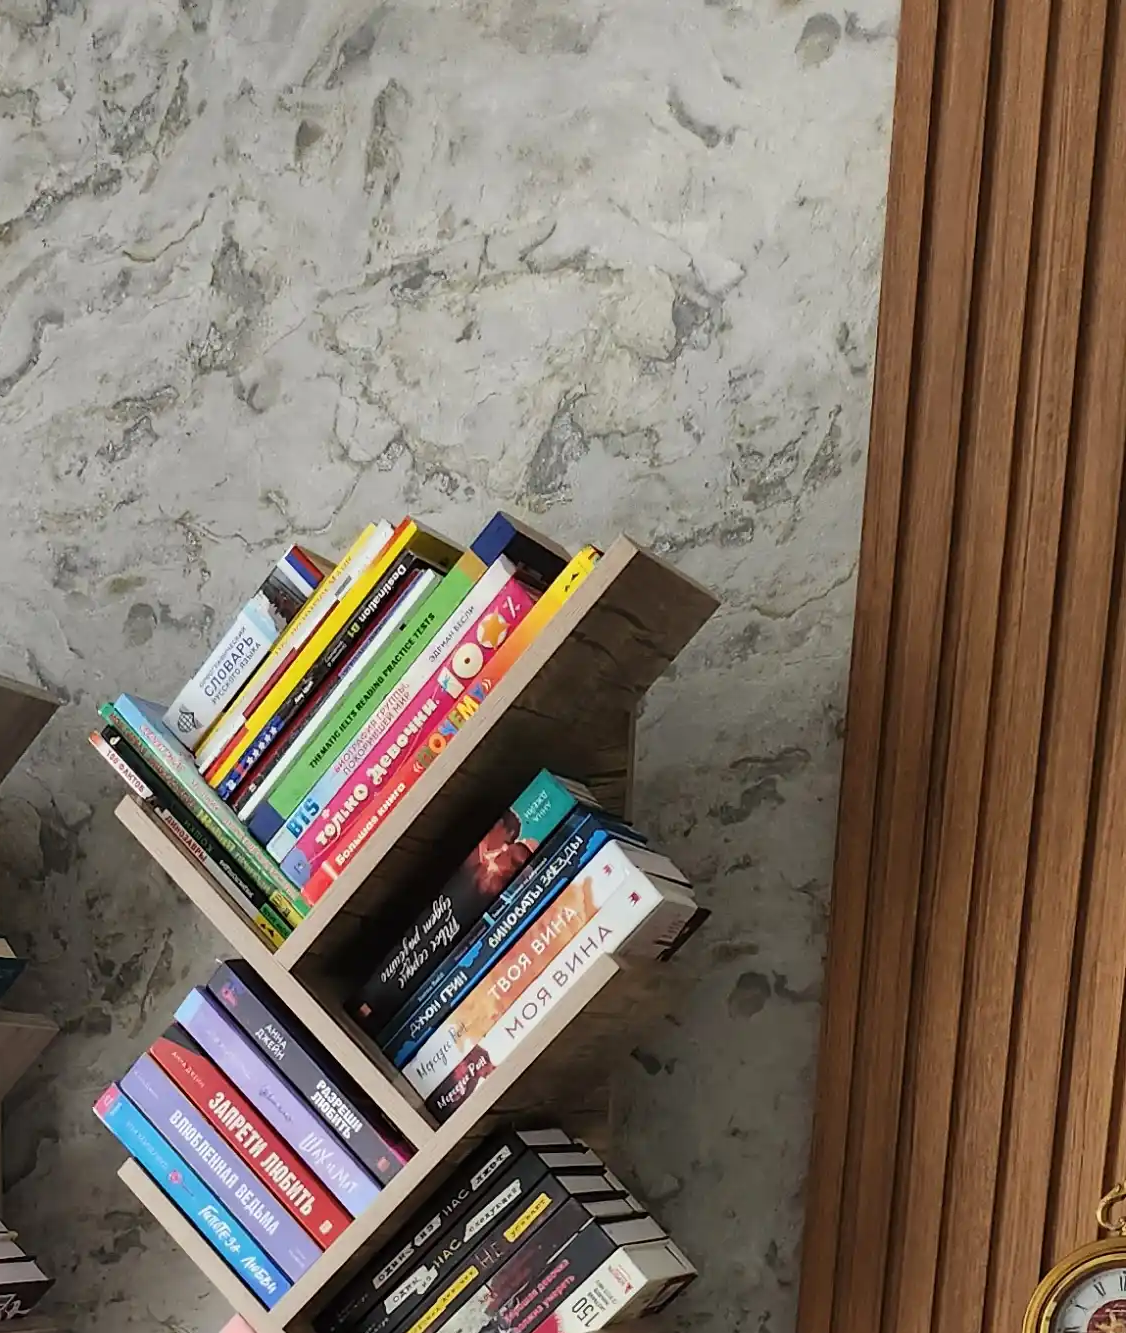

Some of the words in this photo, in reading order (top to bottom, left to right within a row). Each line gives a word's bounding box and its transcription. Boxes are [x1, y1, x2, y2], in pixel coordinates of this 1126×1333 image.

[356, 562, 408, 624] Destination
[451, 604, 476, 633] ВЕСЛИ
[345, 621, 361, 638] B1
[202, 634, 254, 697] СЛОВАРЬ
[210, 667, 241, 705] РУССКОГО
[238, 641, 261, 668] ЯЗЫКА
[308, 730, 342, 769] THEMATIC
[337, 709, 358, 732] IELTS
[354, 675, 385, 711] READING
[381, 638, 415, 677] PRACTICE
[406, 611, 438, 647] TESTS
[331, 718, 379, 774] БИОГРАФИЯ
[340, 711, 395, 775] ПОКОРИВШЕЙ
[391, 690, 411, 713] МИР
[116, 763, 146, 793] ФАКТОВ
[521, 789, 549, 819] ДЖЕЙН
[164, 814, 207, 862] ДИНОЗАВРЫ
[283, 796, 322, 838] BTS
[332, 812, 381, 868] Большая
[374, 779, 408, 817] книга
[531, 800, 552, 823] АННА
[414, 892, 458, 938] будет
[485, 883, 544, 949] ВИНОВАТЫ
[537, 834, 587, 888] ЗВЕЗДЫ
[373, 925, 427, 984] разбито
[484, 951, 535, 1002] ТВОЯ
[527, 902, 579, 955] ВИНА
[501, 984, 555, 1040] МОЯ
[548, 919, 615, 989] ВИНА
[405, 997, 443, 1038] ДЖОН
[437, 970, 469, 1004] ГРИН
[254, 1027, 286, 1061] ДЖЕЙН
[263, 1022, 289, 1050] АННА
[309, 1090, 354, 1140] ЛЮБИТЬ
[314, 1079, 363, 1134] РАЗРЕШИ
[165, 1107, 242, 1189] ВЛЮБЛЕННАЯ
[231, 1182, 283, 1236] ВЕДЬМА
[205, 1090, 268, 1158] ЗАПРЕТИ
[258, 1151, 319, 1217] ЛЮБИТЬ
[534, 1257, 571, 1293] девочка
[539, 1273, 576, 1309] умереть
[569, 1295, 601, 1328] 150
